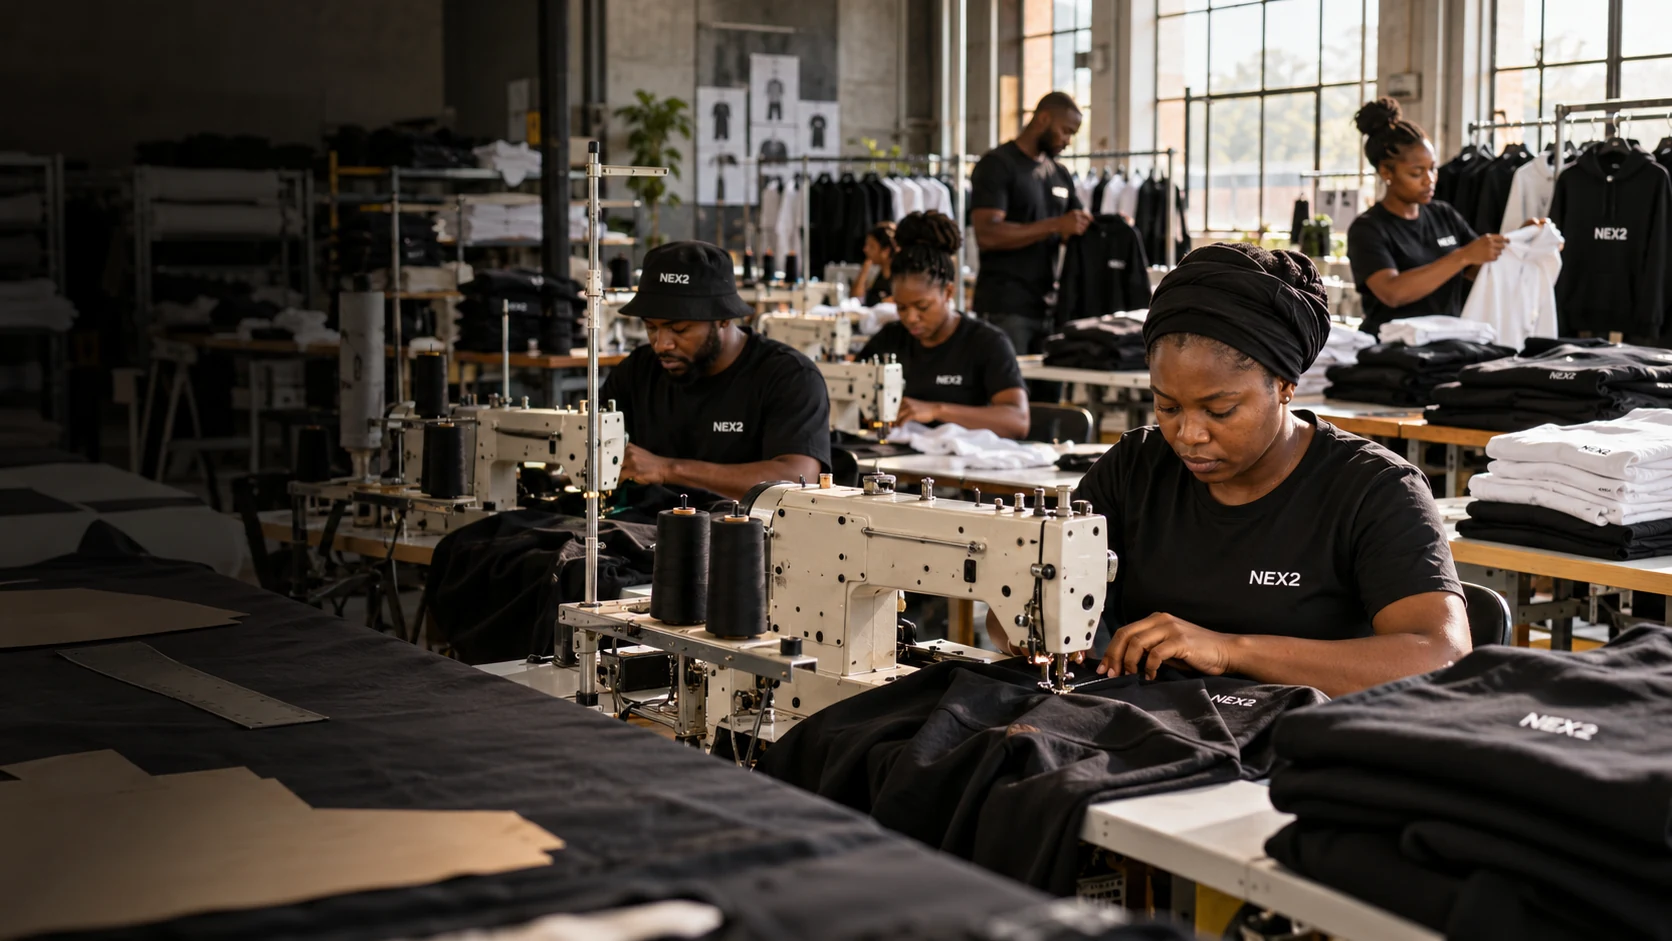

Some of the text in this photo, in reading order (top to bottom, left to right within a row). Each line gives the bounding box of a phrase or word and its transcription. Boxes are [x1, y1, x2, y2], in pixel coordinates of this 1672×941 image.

[1594, 227, 1628, 240] NEX2
[660, 273, 690, 284] NEX2
[1549, 371, 1577, 380] NEX2
[713, 421, 744, 432] NEX2
[1249, 570, 1301, 586] NEX2
[1211, 694, 1257, 707] NEX2
[1519, 711, 1599, 741] NEX2
